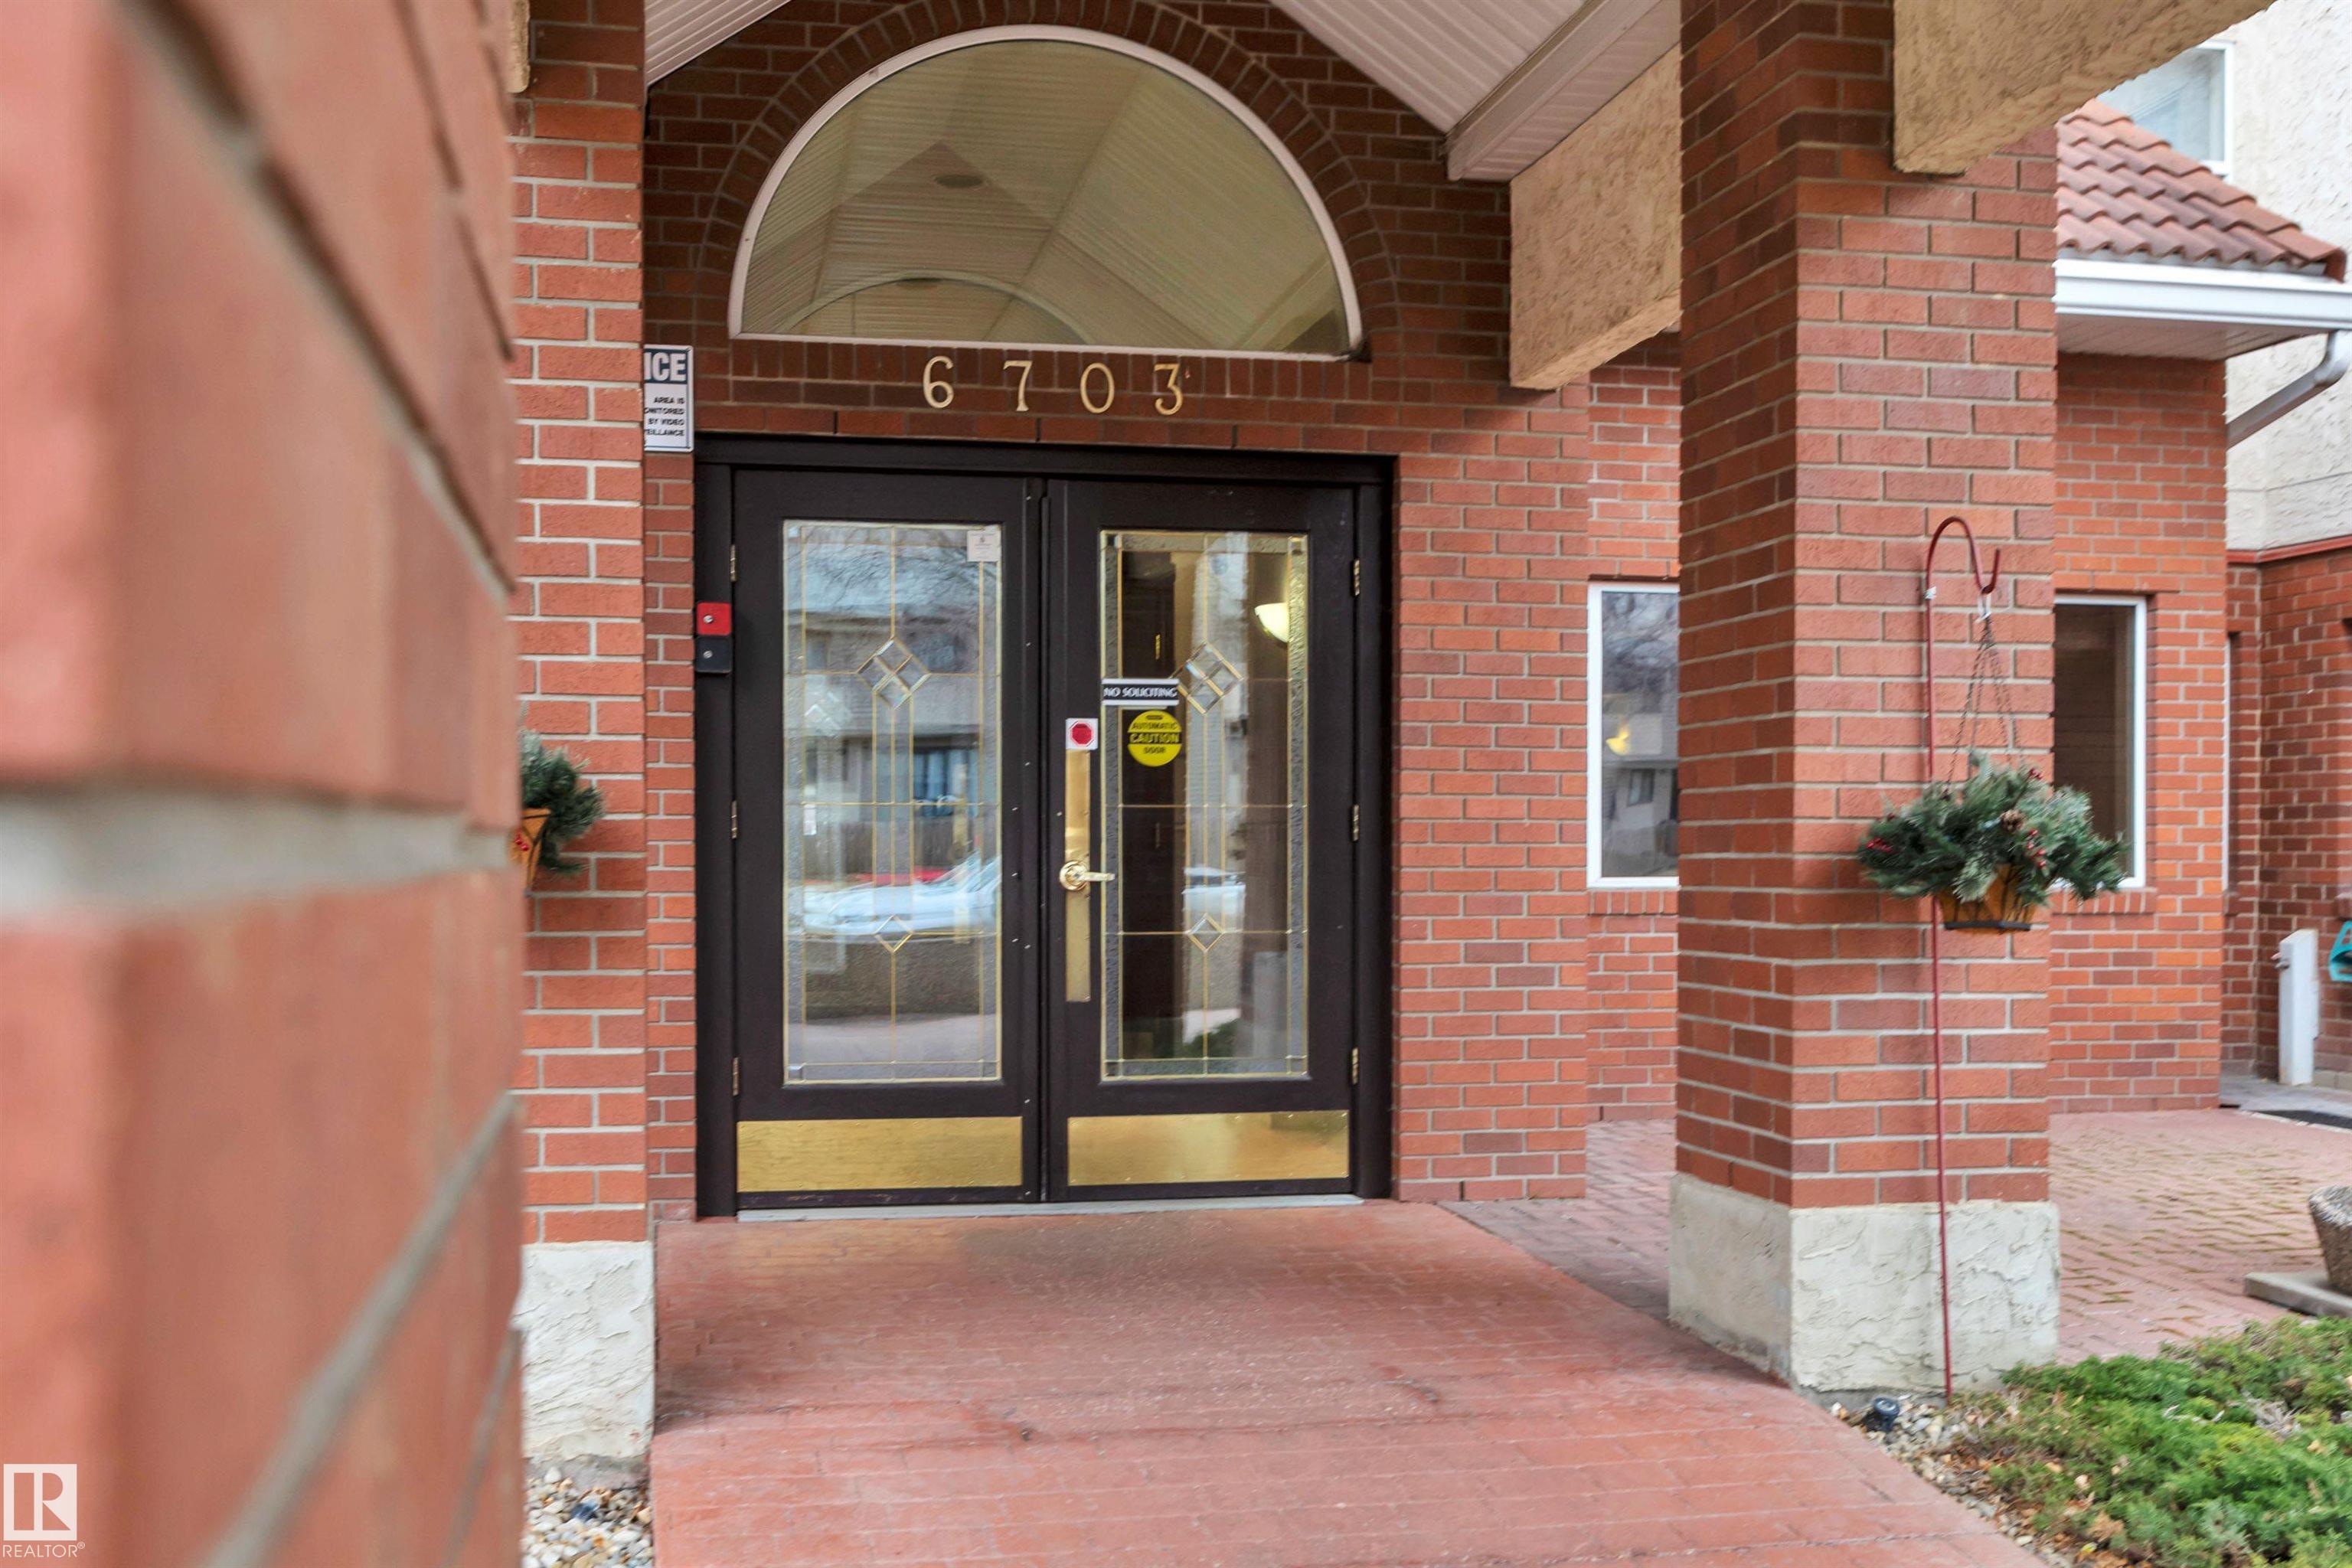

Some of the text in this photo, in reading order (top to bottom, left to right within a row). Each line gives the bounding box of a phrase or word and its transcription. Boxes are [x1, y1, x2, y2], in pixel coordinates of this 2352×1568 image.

[923, 355, 1184, 416] 6703
[1103, 687, 1178, 697] NO SOLICITING
[1132, 721, 1178, 730] AUTOMATIC
[1130, 733, 1180, 743] CAUTION
